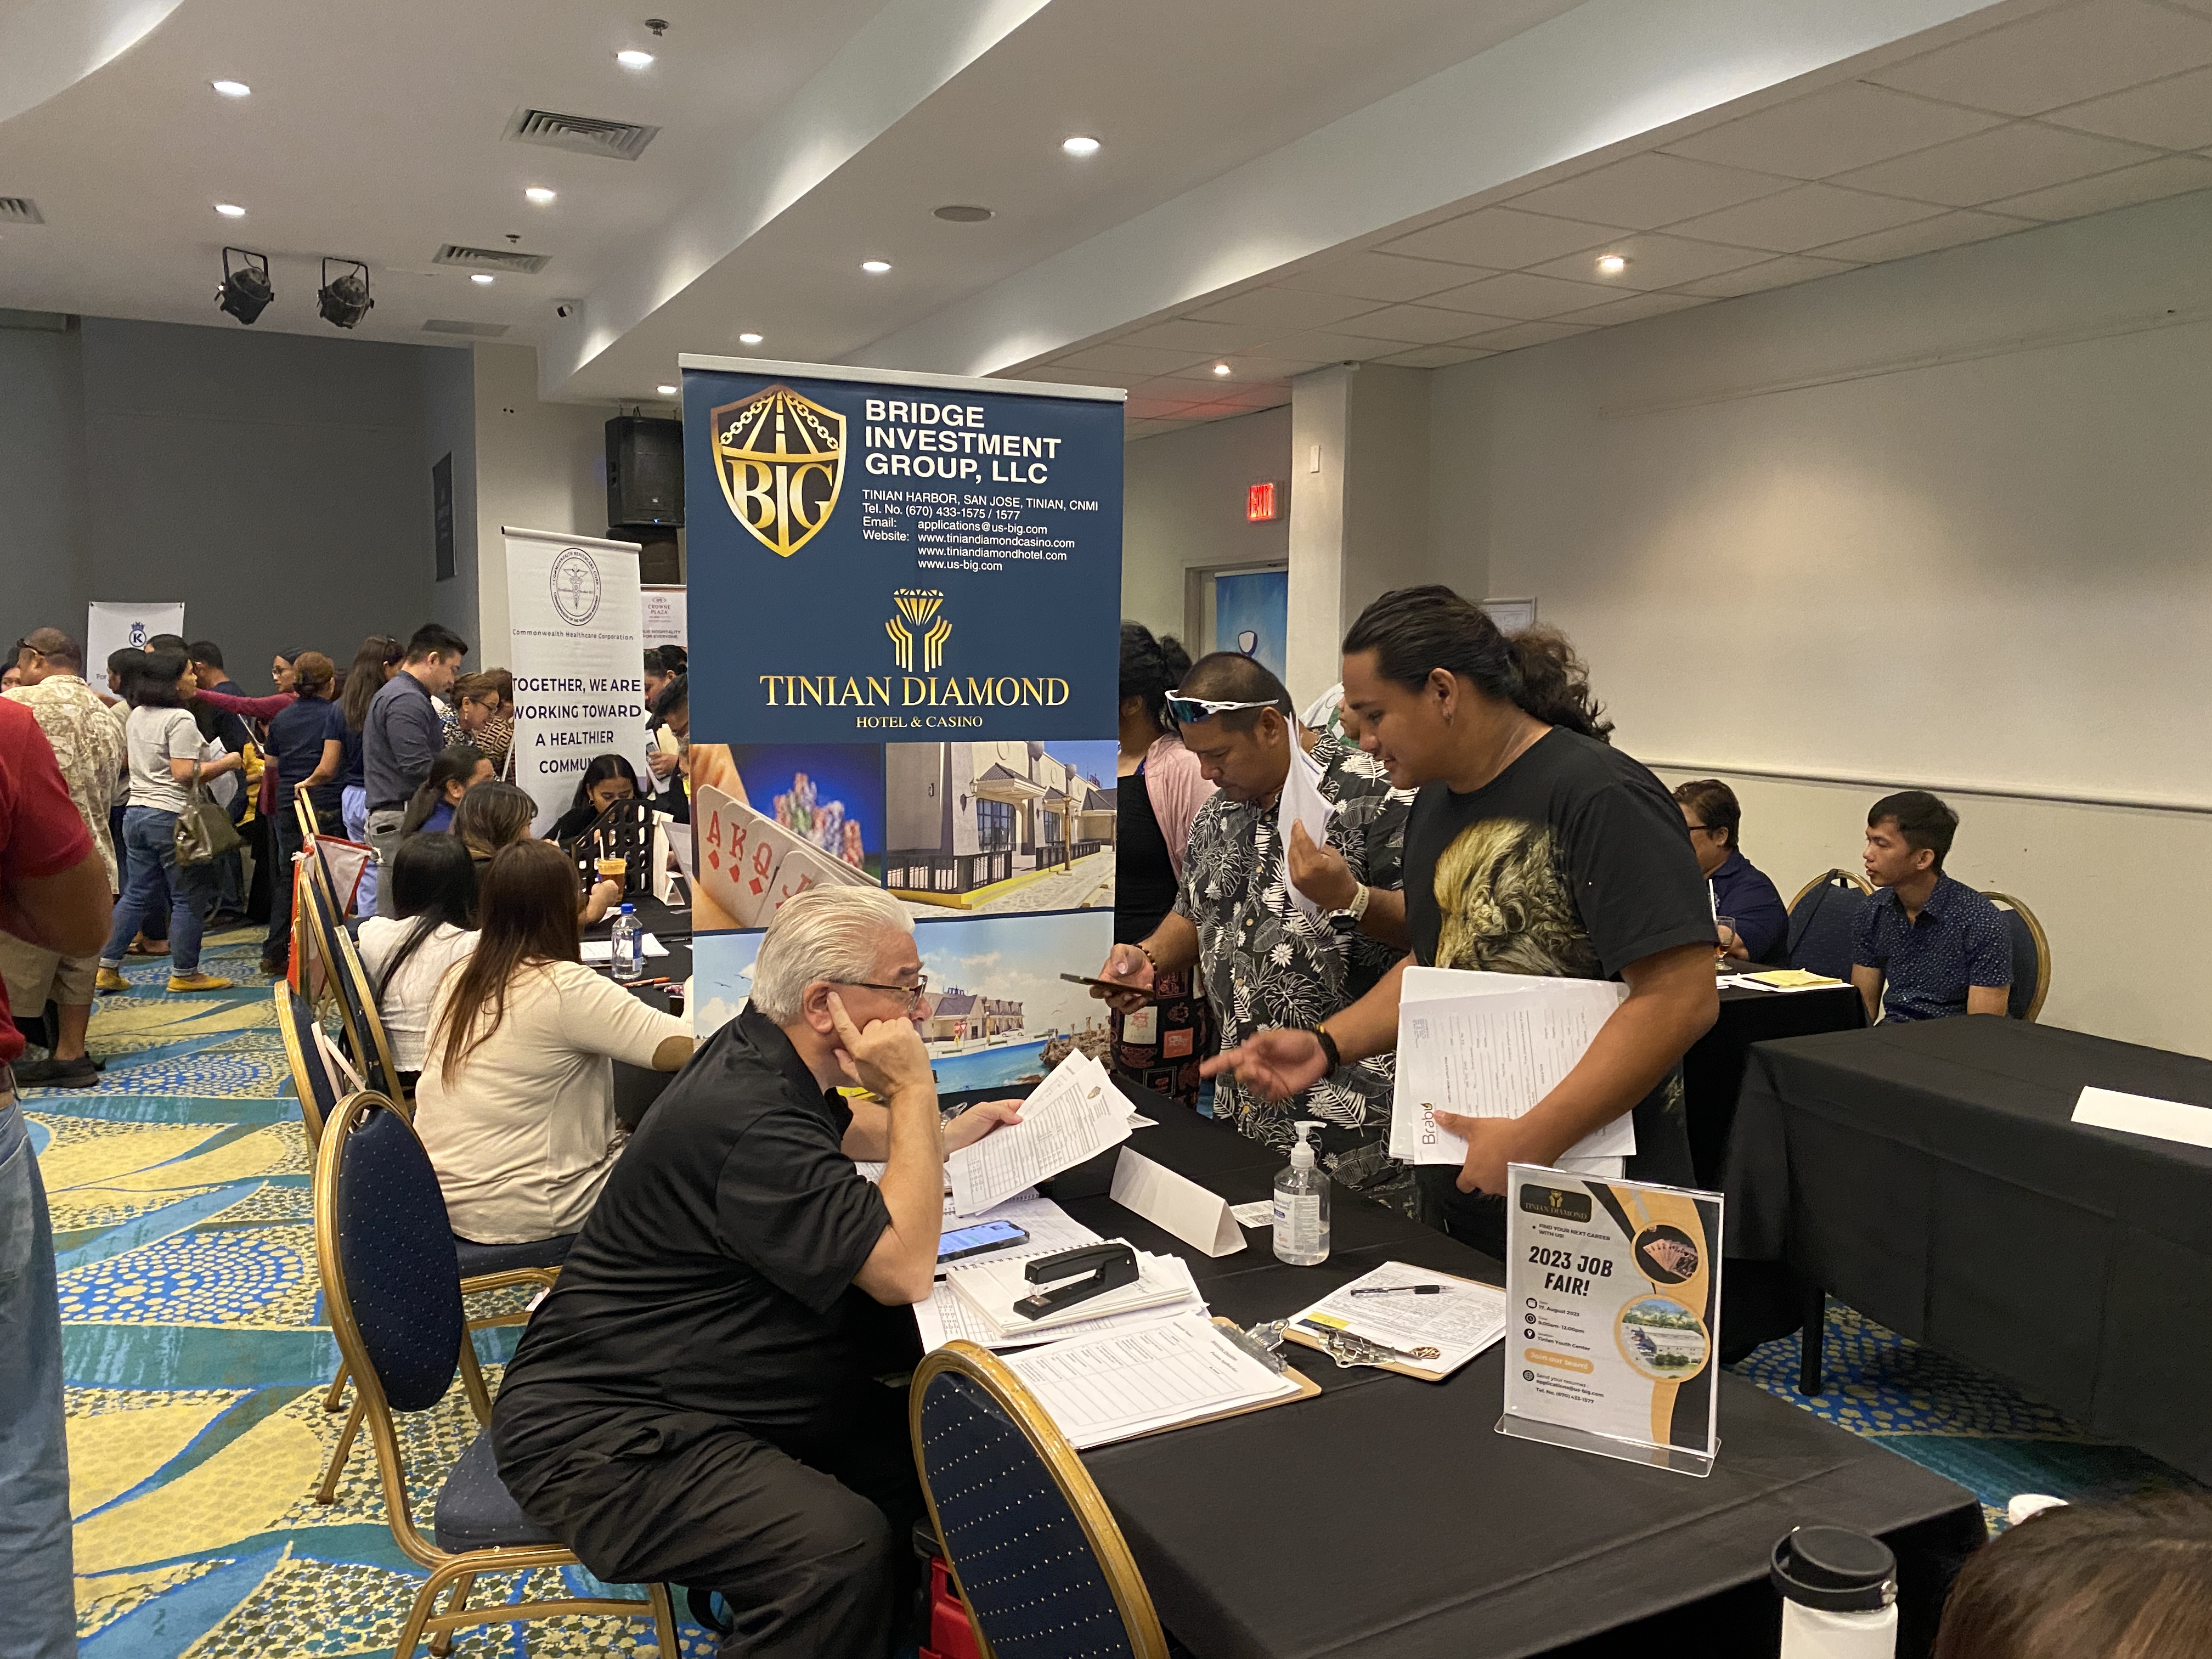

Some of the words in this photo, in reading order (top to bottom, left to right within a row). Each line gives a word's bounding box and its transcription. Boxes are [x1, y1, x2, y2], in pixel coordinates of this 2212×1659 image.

[865, 399, 985, 428] BRIDGE
[865, 426, 1062, 459] INVESTMENT
[865, 453, 982, 484] GROUP,
[992, 461, 1048, 484] LLC
[726, 459, 834, 538] BIG
[862, 489, 902, 501] TINIAN
[906, 492, 960, 506] HARBOR,
[963, 494, 986, 505] SAN
[990, 496, 1023, 509] JOSE,
[1026, 498, 1066, 511] TINIAN,
[1069, 500, 1098, 511] CNMI
[862, 503, 882, 514] Tel.
[885, 505, 902, 515] No.
[905, 506, 933, 517] (670)
[936, 506, 986, 518] 433-1575
[995, 510, 1020, 520] 1577
[862, 516, 897, 528] Email:
[917, 520, 1047, 535] applications@us-big.com
[862, 529, 910, 541] Website:
[917, 532, 1075, 549] www.tiniandiamondcasino.com
[917, 546, 1067, 561] www.tiniandiamondhotel.com
[917, 559, 1003, 572] www.us-big.com
[133, 633, 143, 643] K
[512, 629, 564, 637] Commonwealth
[512, 678, 585, 694] TOGETHER,
[589, 679, 607, 691] WE
[610, 679, 641, 692] ARE
[760, 675, 891, 707] TINIAN
[901, 676, 1069, 707] DIAMOND
[514, 705, 578, 720] WORKING
[582, 704, 642, 718] TOWARD
[856, 716, 907, 729] HOTEL
[910, 716, 922, 728] &
[926, 715, 983, 728] CASINO
[535, 733, 546, 747] A
[550, 731, 614, 746] HEALTHIER
[706, 810, 721, 848] A
[729, 822, 747, 861] K
[752, 842, 772, 879] Q
[1525, 1202, 1549, 1213] TINIAN
[1550, 1207, 1588, 1220] DIAMOND
[1528, 1245, 1572, 1269] 2023
[1577, 1255, 1613, 1277] JOB
[1544, 1272, 1590, 1296] FAIR!
[1530, 1352, 1548, 1361] Join
[1536, 1380, 1604, 1398] applications@us-big.com
